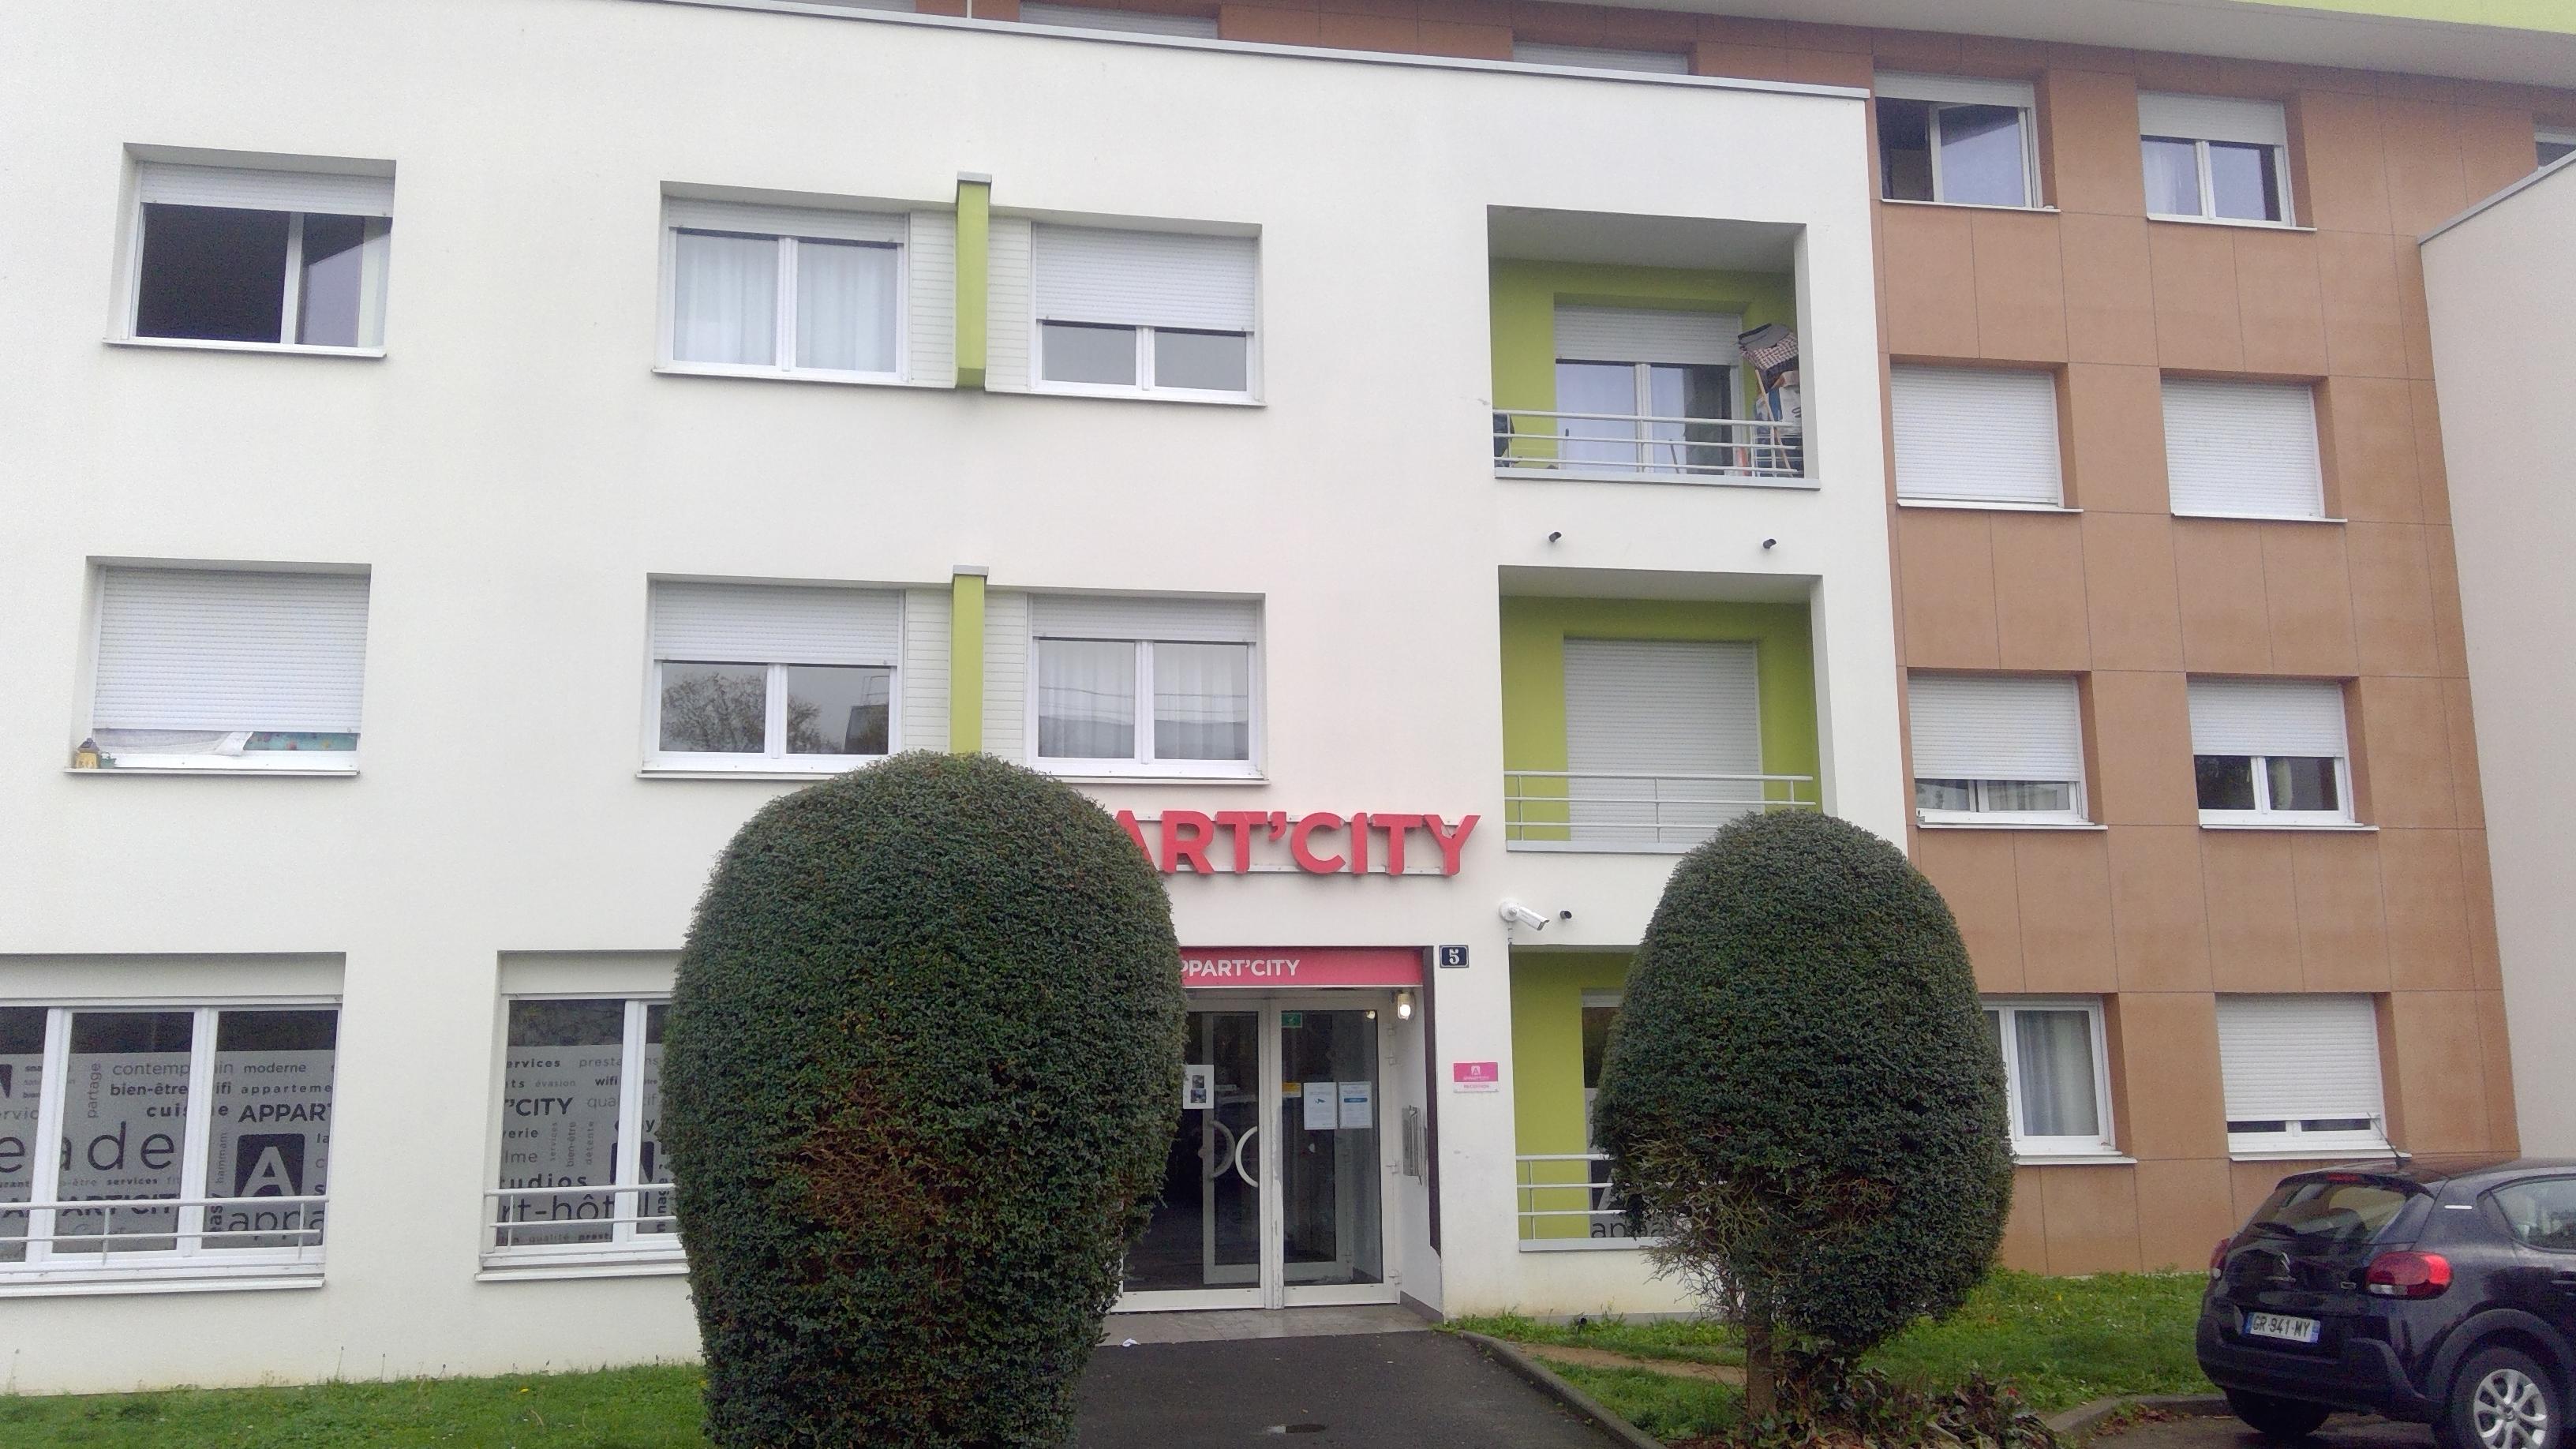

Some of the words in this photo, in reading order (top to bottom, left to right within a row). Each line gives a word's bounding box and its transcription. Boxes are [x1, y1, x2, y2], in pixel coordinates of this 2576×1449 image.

[1448, 949, 1460, 964] 5
[244, 1062, 306, 1074] moderne
[595, 1076, 618, 1087] wifi
[88, 1062, 102, 1118] partage
[110, 1083, 189, 1096] bien-être
[107, 1177, 158, 1185] services
